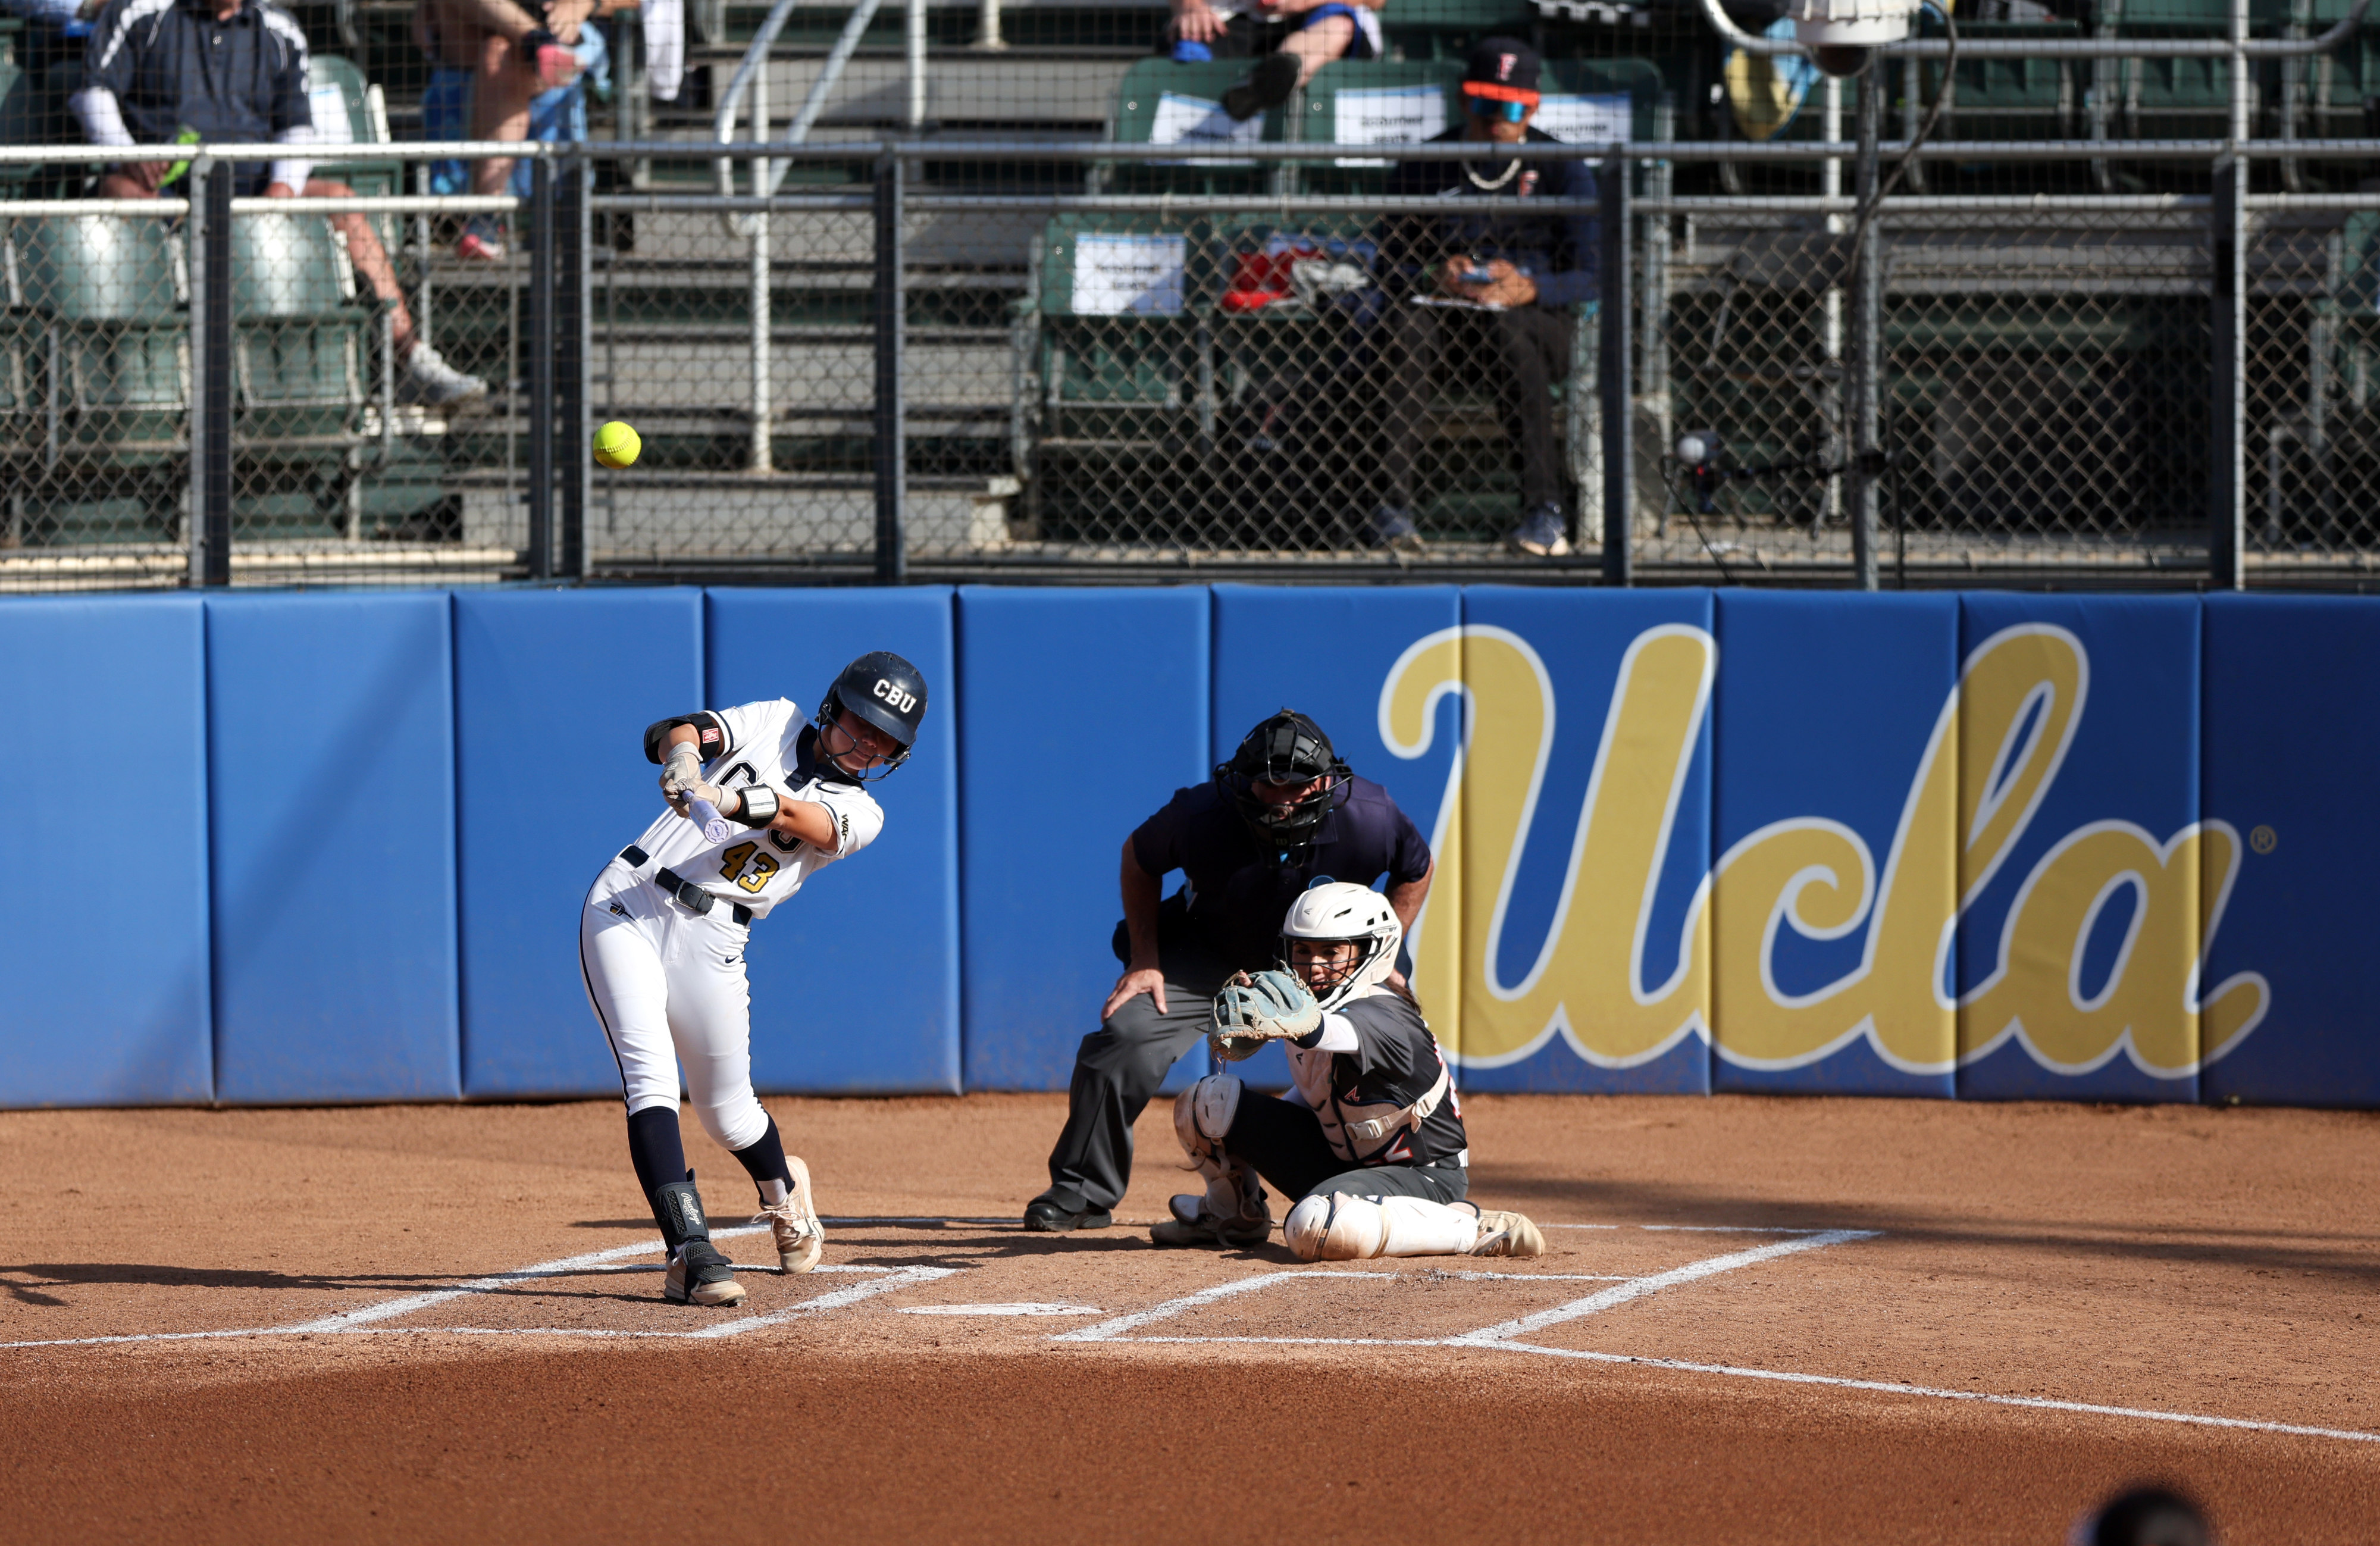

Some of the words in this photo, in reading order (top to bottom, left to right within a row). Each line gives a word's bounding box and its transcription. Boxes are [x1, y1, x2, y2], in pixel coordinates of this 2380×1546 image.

[1496, 52, 1518, 82] F
[873, 678, 917, 713] CBU
[718, 840, 781, 894] 43
[681, 1193, 701, 1225] Rawlings
